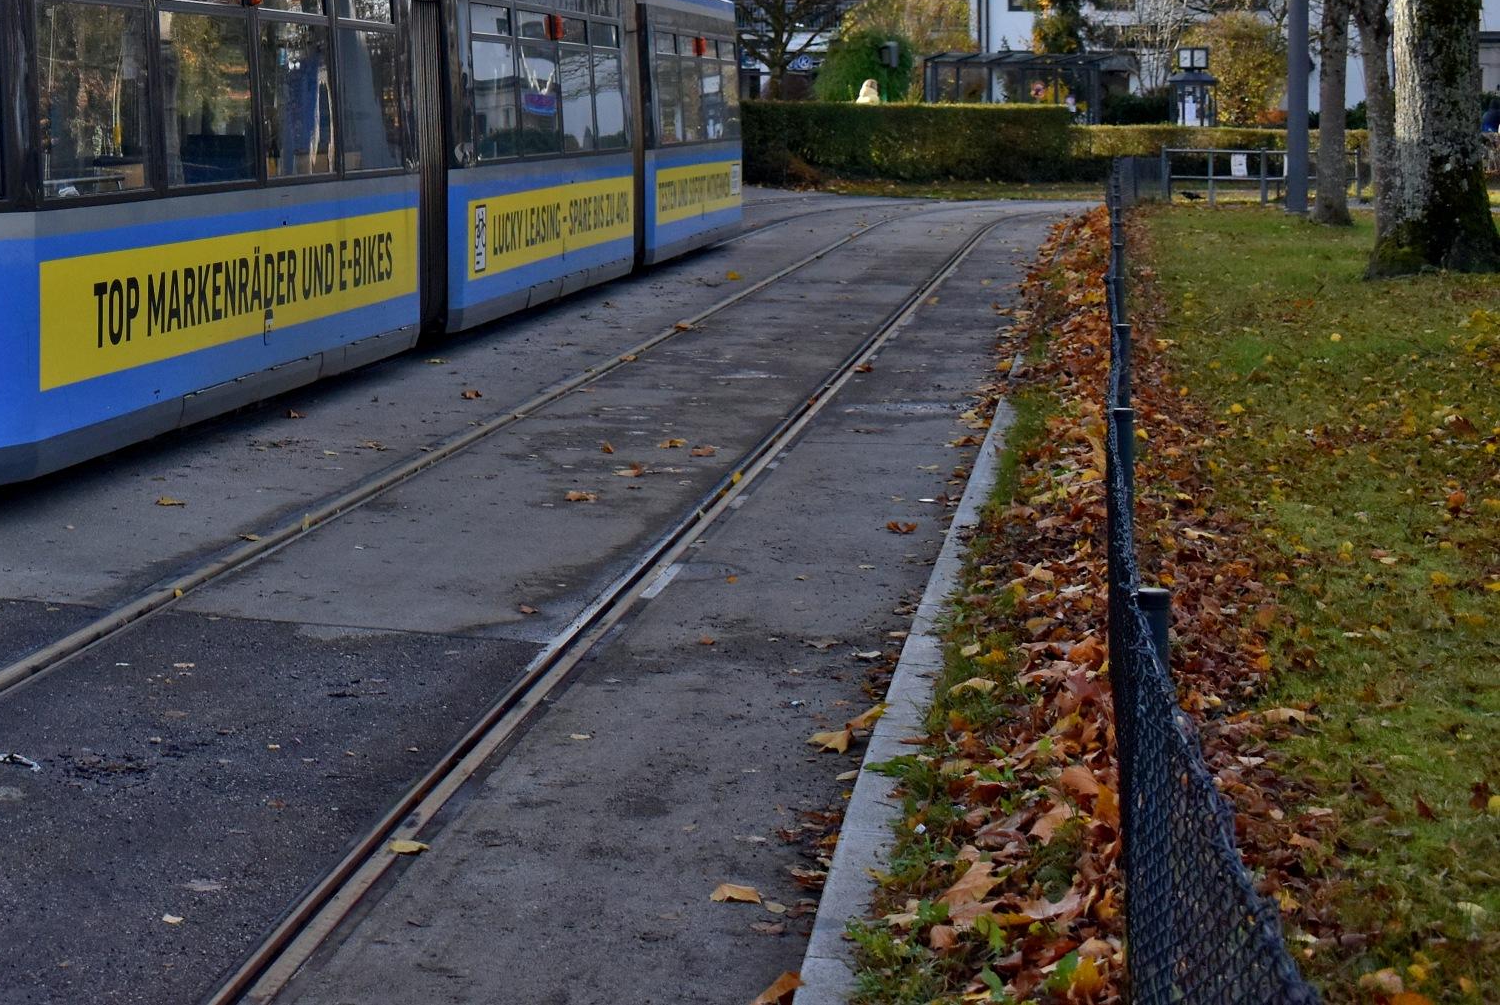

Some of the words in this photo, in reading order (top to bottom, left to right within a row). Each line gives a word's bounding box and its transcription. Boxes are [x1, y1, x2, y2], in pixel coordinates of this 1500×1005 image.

[493, 212, 524, 256] LUCKY
[525, 202, 561, 247] LEASING
[569, 196, 592, 235] SPARE
[593, 194, 604, 229] BIS
[605, 193, 615, 228] ZU
[93, 276, 140, 348] TOP
[147, 246, 297, 337] MARKENRÄDER
[302, 243, 335, 301] UND
[339, 231, 393, 291] E-BIKES
